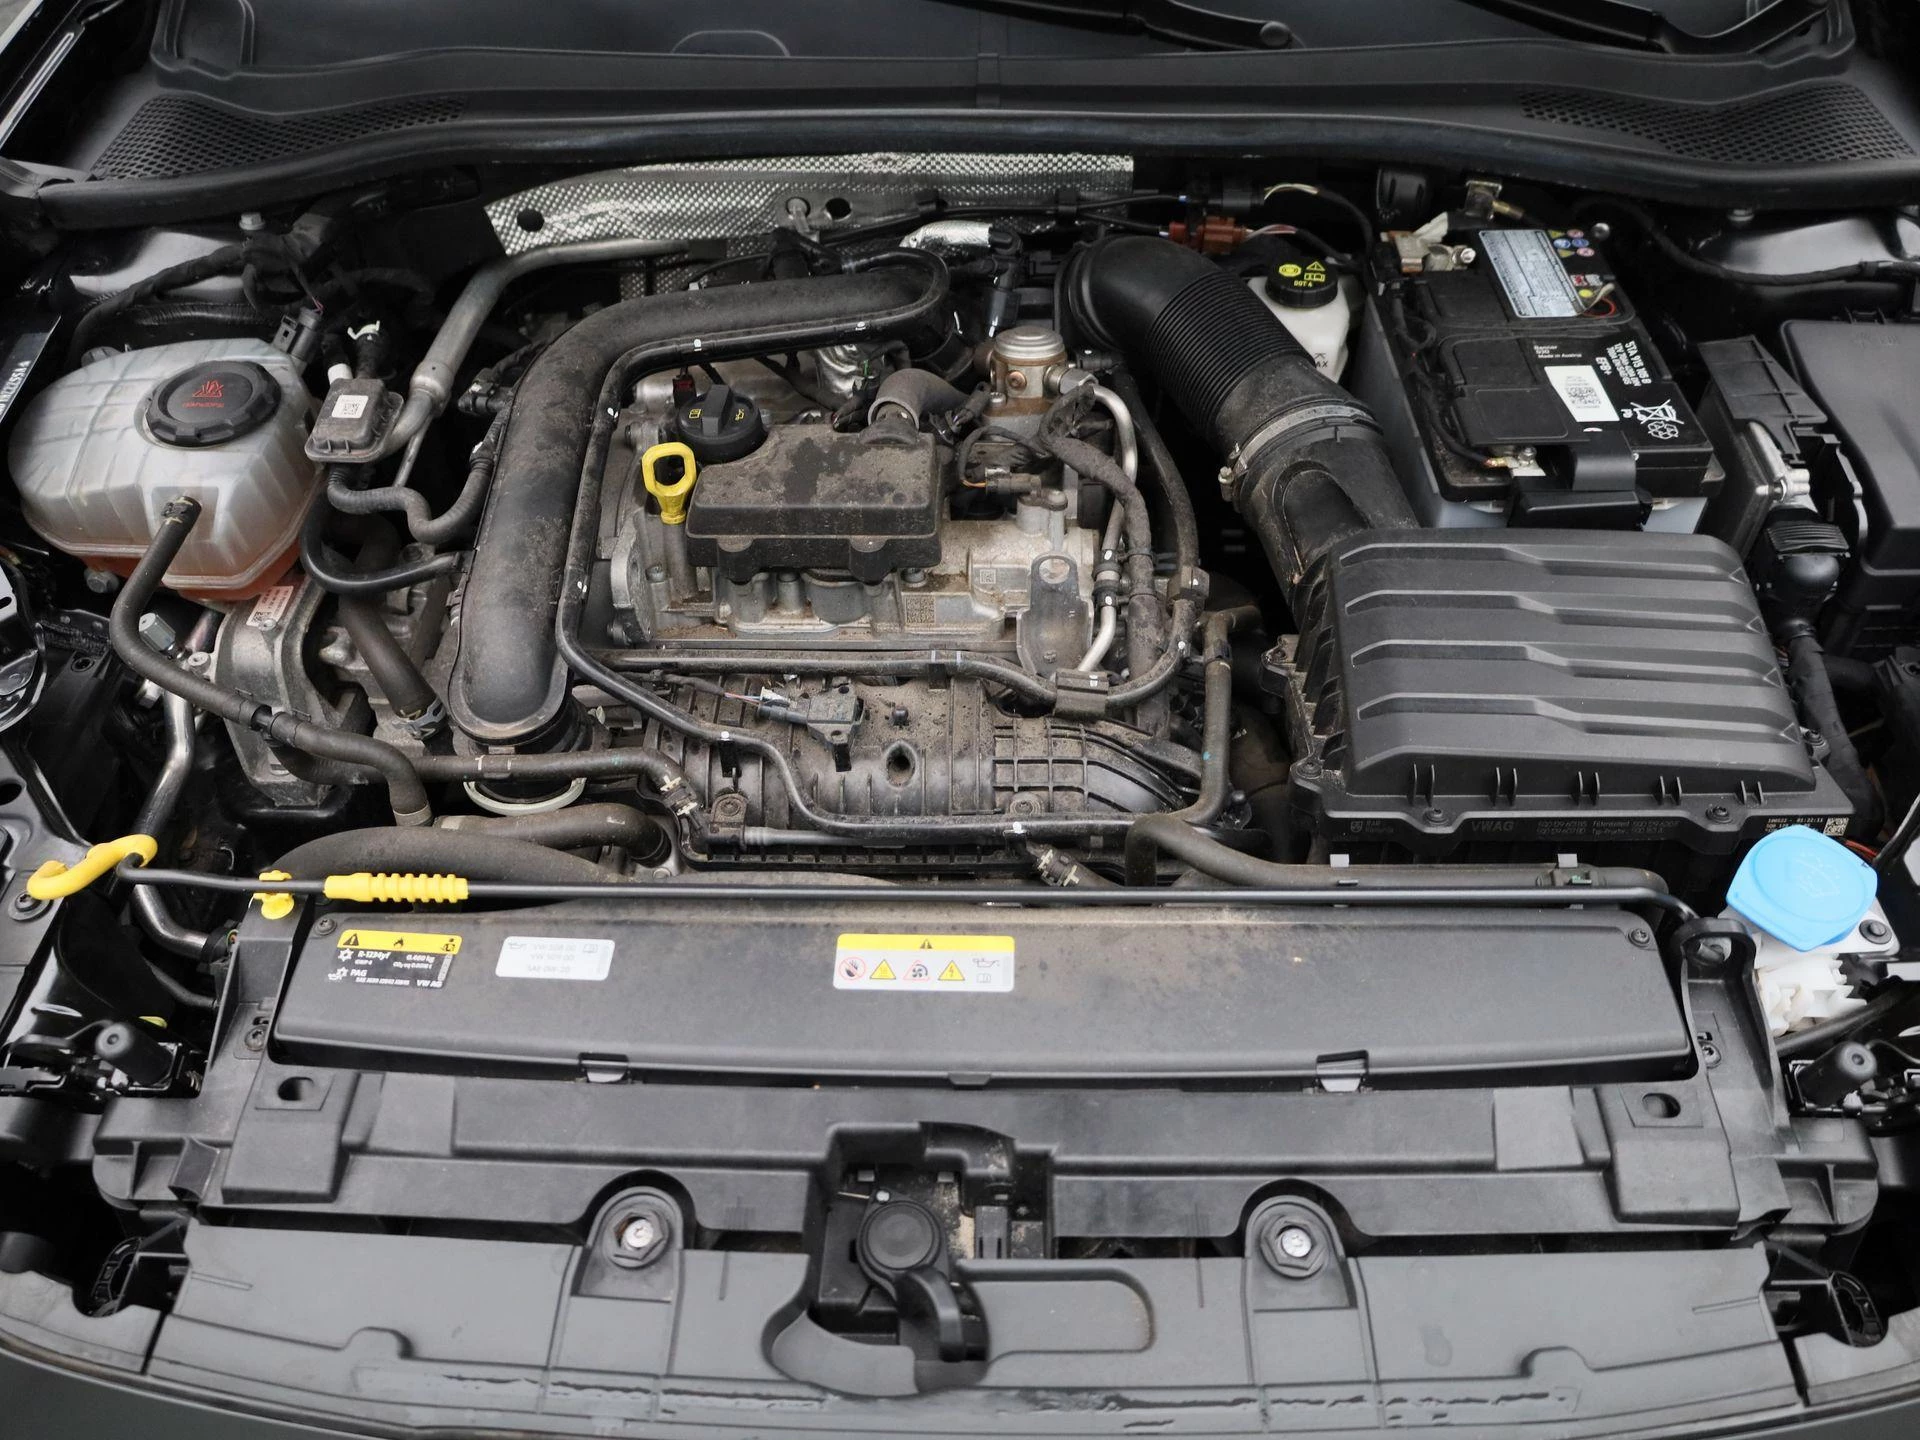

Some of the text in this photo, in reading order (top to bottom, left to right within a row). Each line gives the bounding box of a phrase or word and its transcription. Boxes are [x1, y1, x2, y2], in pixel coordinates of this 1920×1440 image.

[1595, 357, 1612, 375] EFB+
[1471, 820, 1514, 832] VWAG
[357, 950, 391, 961] R-1234yf
[350, 969, 368, 977] PAG
